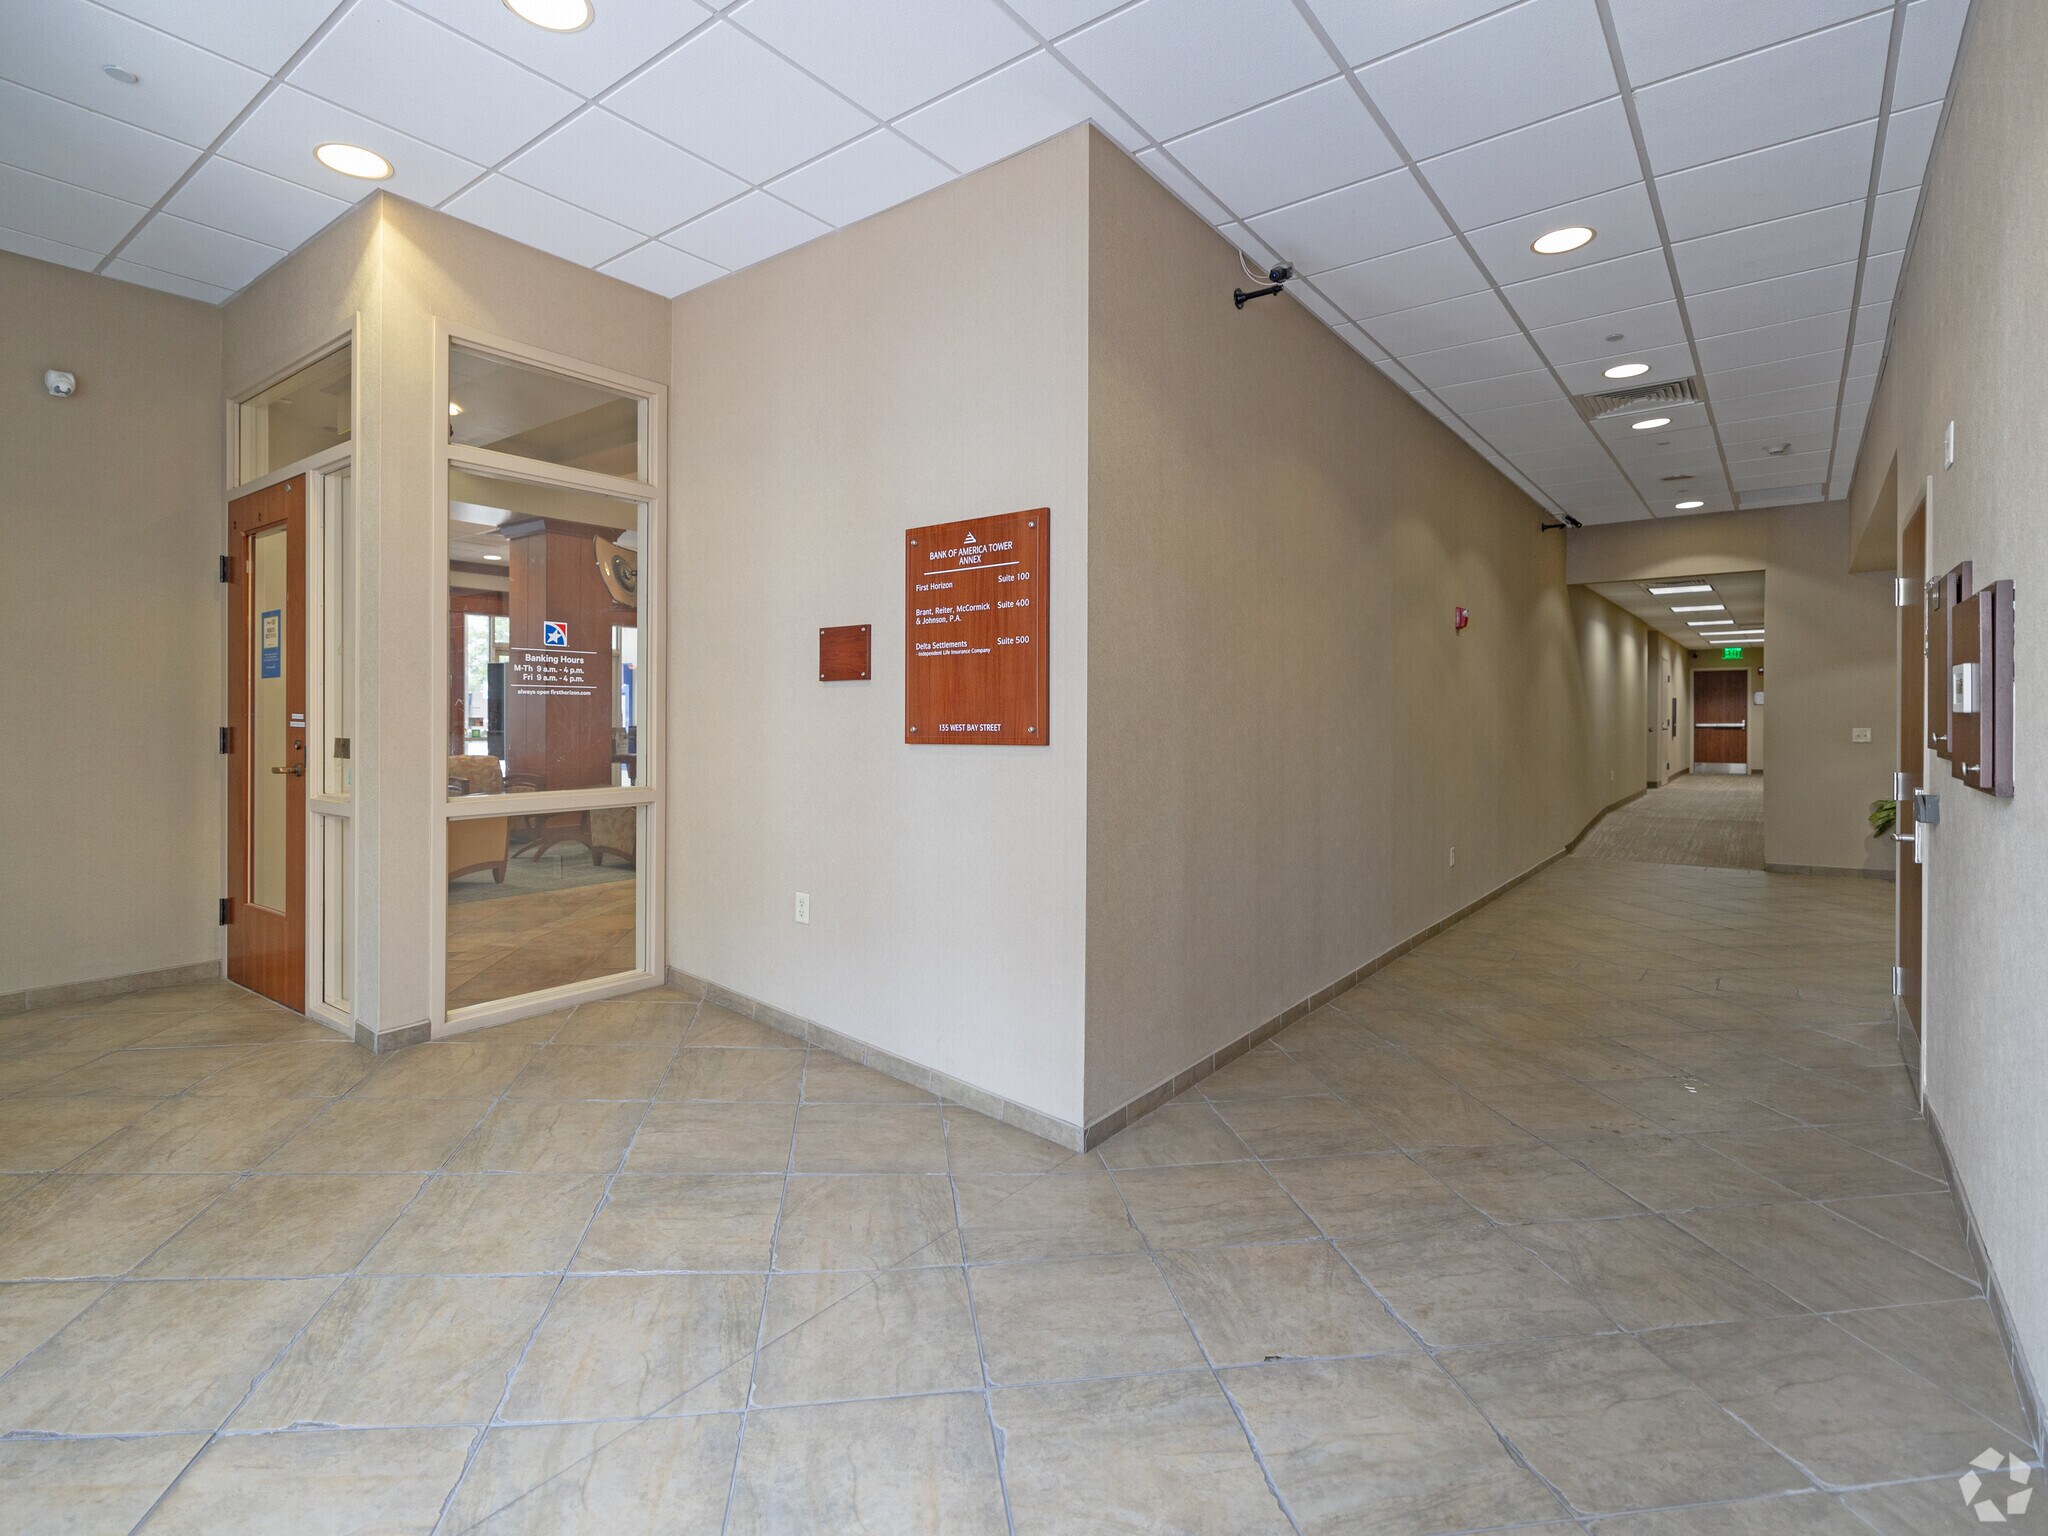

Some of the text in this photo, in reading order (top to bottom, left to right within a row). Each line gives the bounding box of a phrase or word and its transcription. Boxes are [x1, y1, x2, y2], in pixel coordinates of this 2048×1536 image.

[930, 541, 1013, 561] BANK OF AMERICA TOWER
[959, 555, 982, 565] ANNEX
[998, 572, 1030, 583] Suite 100
[916, 582, 953, 592] First Horizon
[956, 603, 990, 613] McCormick
[997, 599, 1030, 609] Suite 400
[922, 616, 948, 624] Johnson,
[950, 614, 962, 622] P.A.
[932, 641, 967, 649] Settlements
[997, 637, 1014, 645] Suite
[1724, 647, 1742, 659] EXIT
[525, 654, 584, 664] Banking Hours
